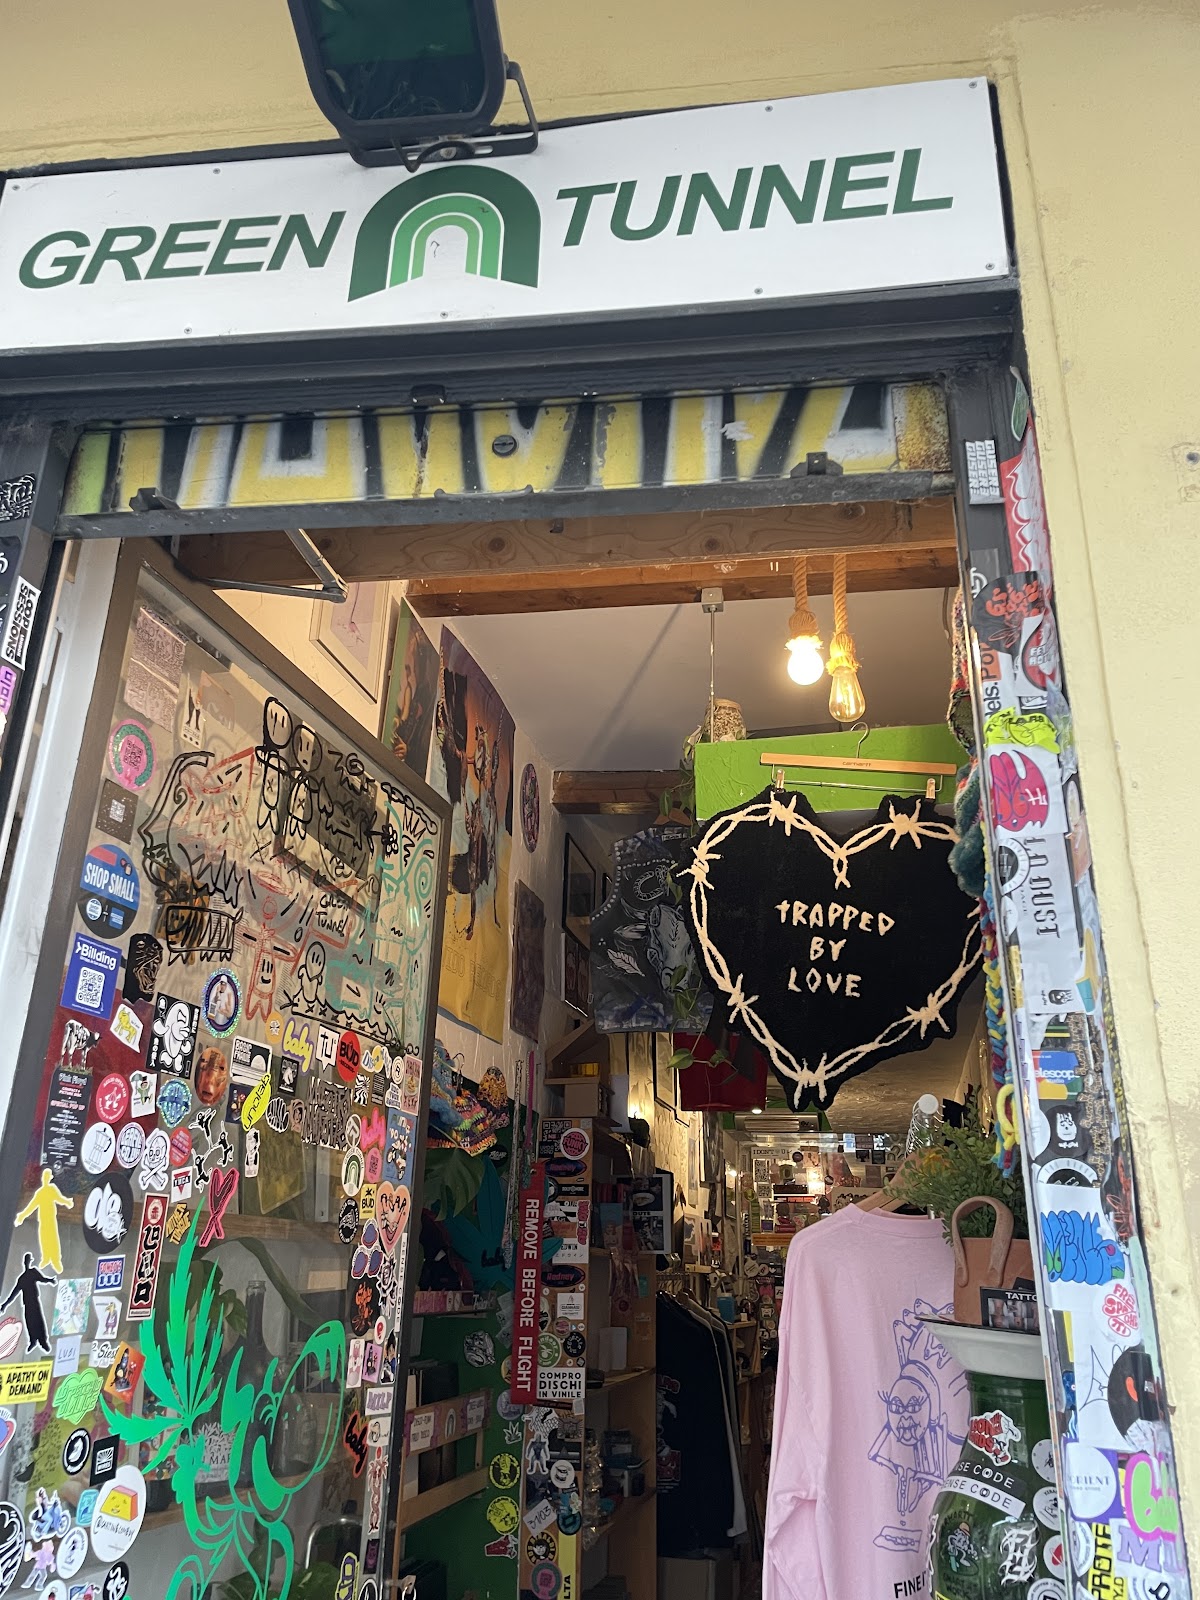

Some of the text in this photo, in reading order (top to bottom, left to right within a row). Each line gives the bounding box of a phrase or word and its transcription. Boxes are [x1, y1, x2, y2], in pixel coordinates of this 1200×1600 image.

[19, 148, 954, 290] GREEN TUNNEL
[6, 582, 29, 660] SESSIONS
[20, 589, 37, 629] LOOP
[84, 862, 135, 903] SHOP SMALL
[774, 900, 896, 936] TRAPPED
[809, 936, 847, 962] BY
[787, 966, 862, 998] LOVE
[516, 1199, 540, 1392] REMOVE BEFORE FLIGHT
[6, 1369, 48, 1384] APATHY ON
[9, 1383, 42, 1396] DEMAND
[539, 1372, 582, 1380] COMPRO
[539, 1380, 582, 1390] DISCHI
[973, 1464, 1016, 1489] CODE
[970, 1485, 1011, 1509] CODE
